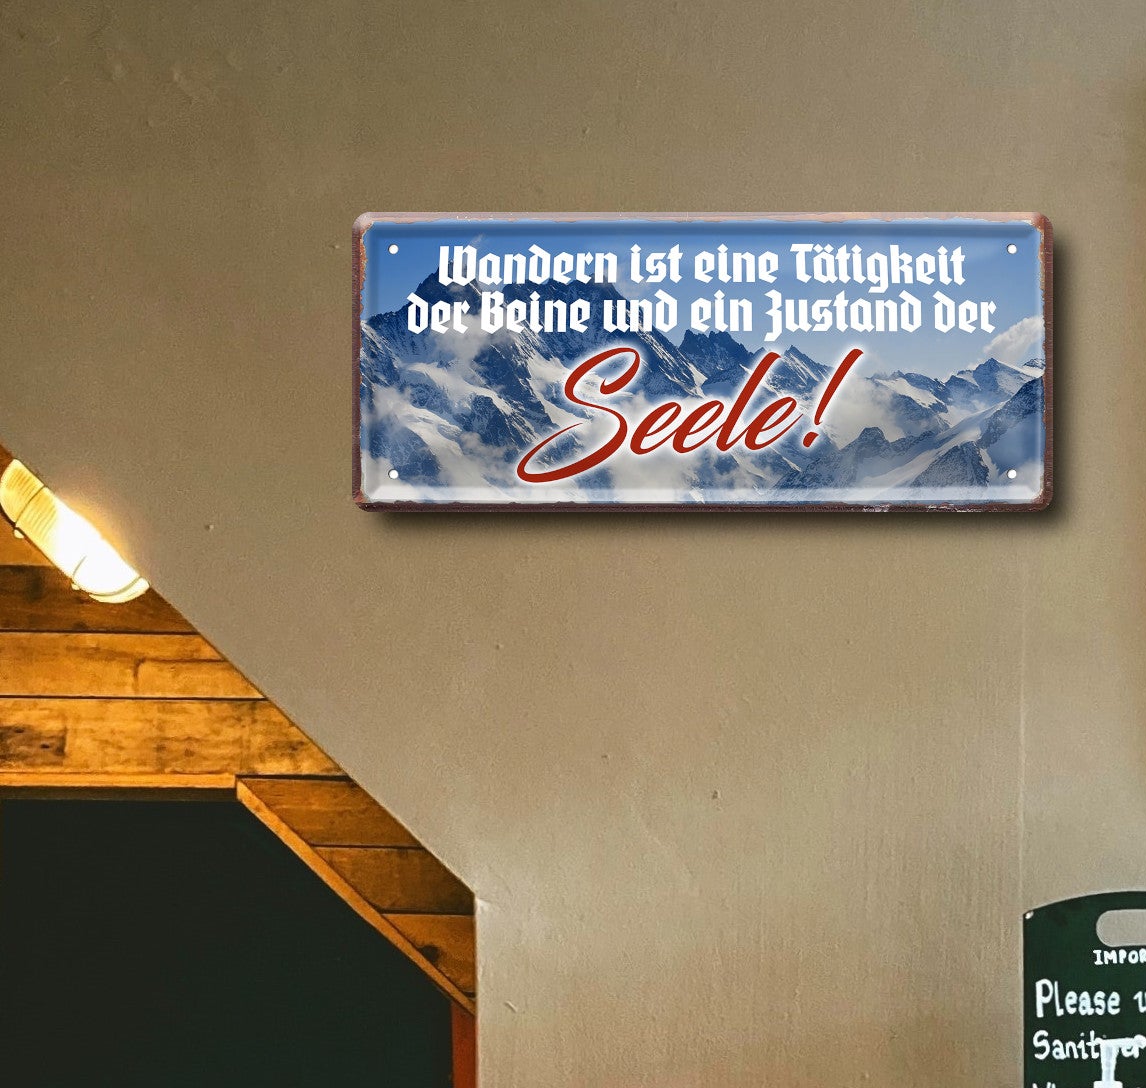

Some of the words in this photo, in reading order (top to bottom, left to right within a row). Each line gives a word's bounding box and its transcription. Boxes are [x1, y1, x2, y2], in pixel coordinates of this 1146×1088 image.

[438, 244, 618, 287] Wandern
[630, 244, 683, 284] ist
[694, 243, 779, 284] eine
[789, 243, 966, 293] Tätigkeit
[406, 292, 470, 335] der
[480, 290, 590, 334] Beine
[603, 290, 678, 333] und
[690, 291, 753, 333] ein
[764, 290, 922, 342] Zustand
[932, 290, 997, 334] der
[516, 346, 864, 483] Seele!
[1035, 978, 1121, 1018] Please
